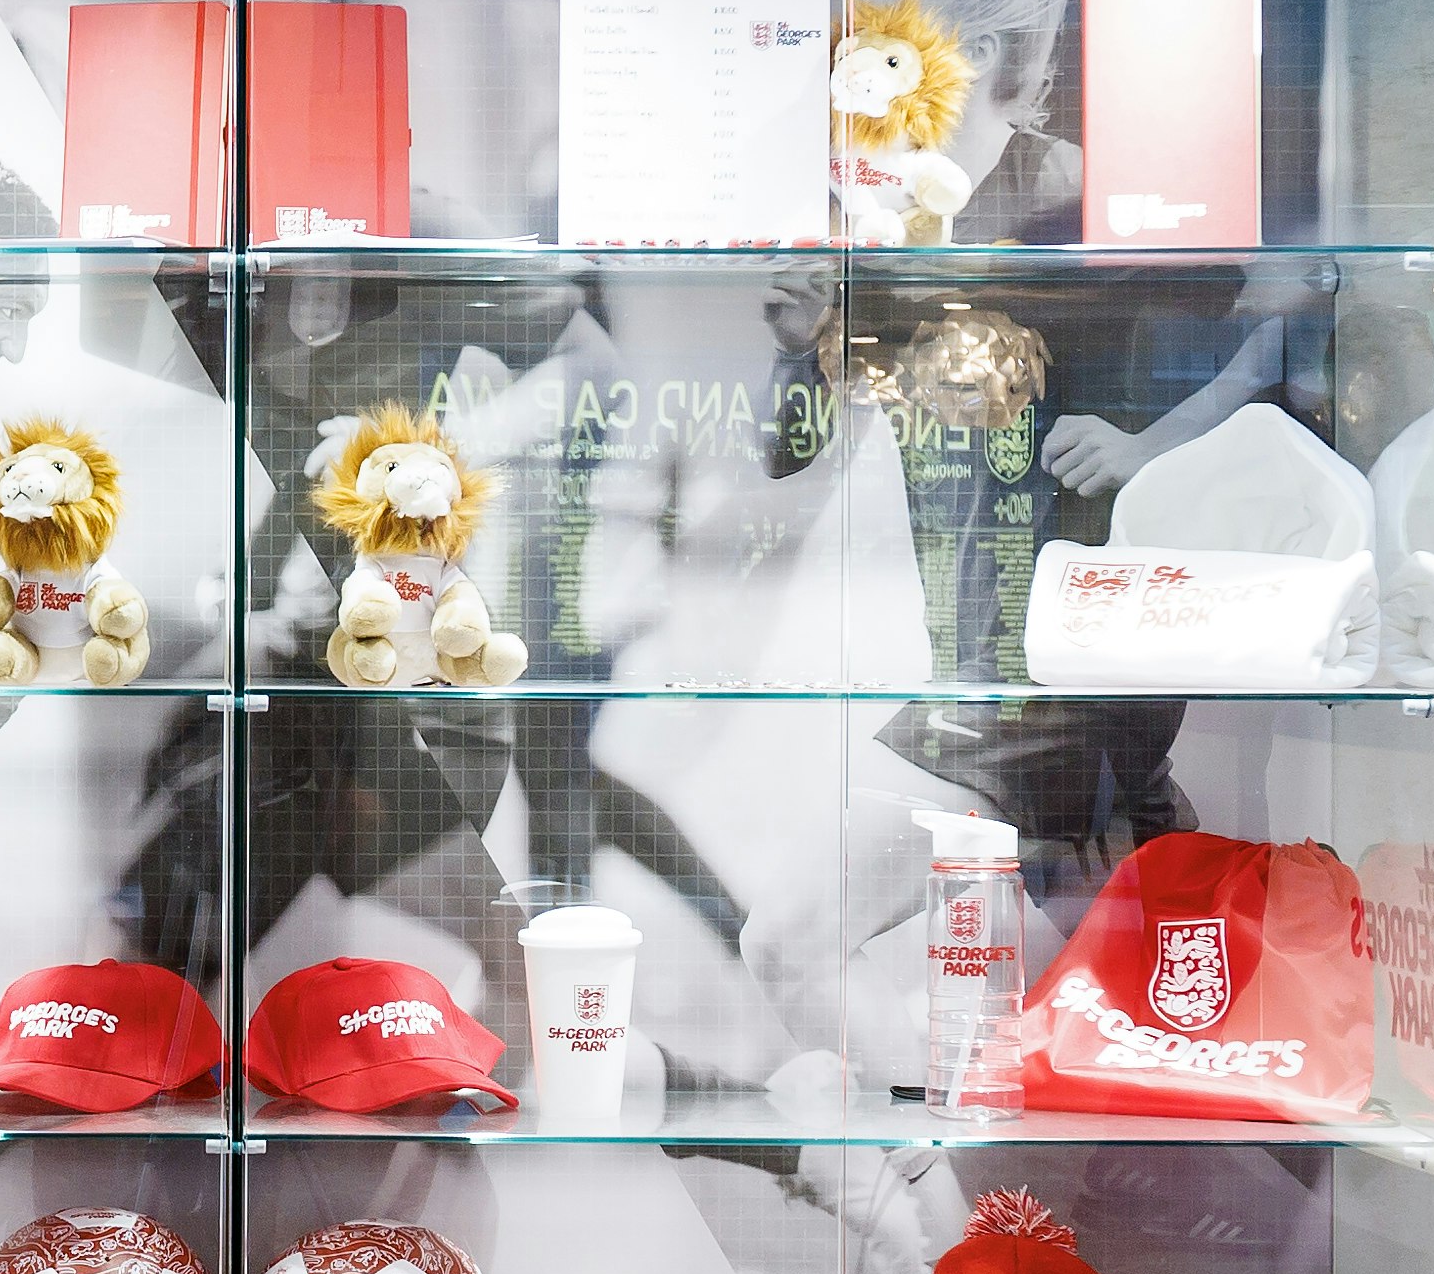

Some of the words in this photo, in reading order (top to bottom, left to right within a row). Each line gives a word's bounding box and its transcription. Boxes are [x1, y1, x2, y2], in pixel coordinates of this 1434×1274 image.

[1141, 578, 1286, 607] GEORGE'S
[1136, 607, 1213, 630] PARK
[943, 962, 989, 976] PARK
[23, 1001, 119, 1034] GEORGE'S
[20, 1019, 78, 1039] PARK
[381, 1018, 436, 1039] PARK
[565, 1026, 625, 1040] GEORGE'S
[570, 1040, 608, 1052] PARK
[1097, 1008, 1308, 1078] GEORGE'S
